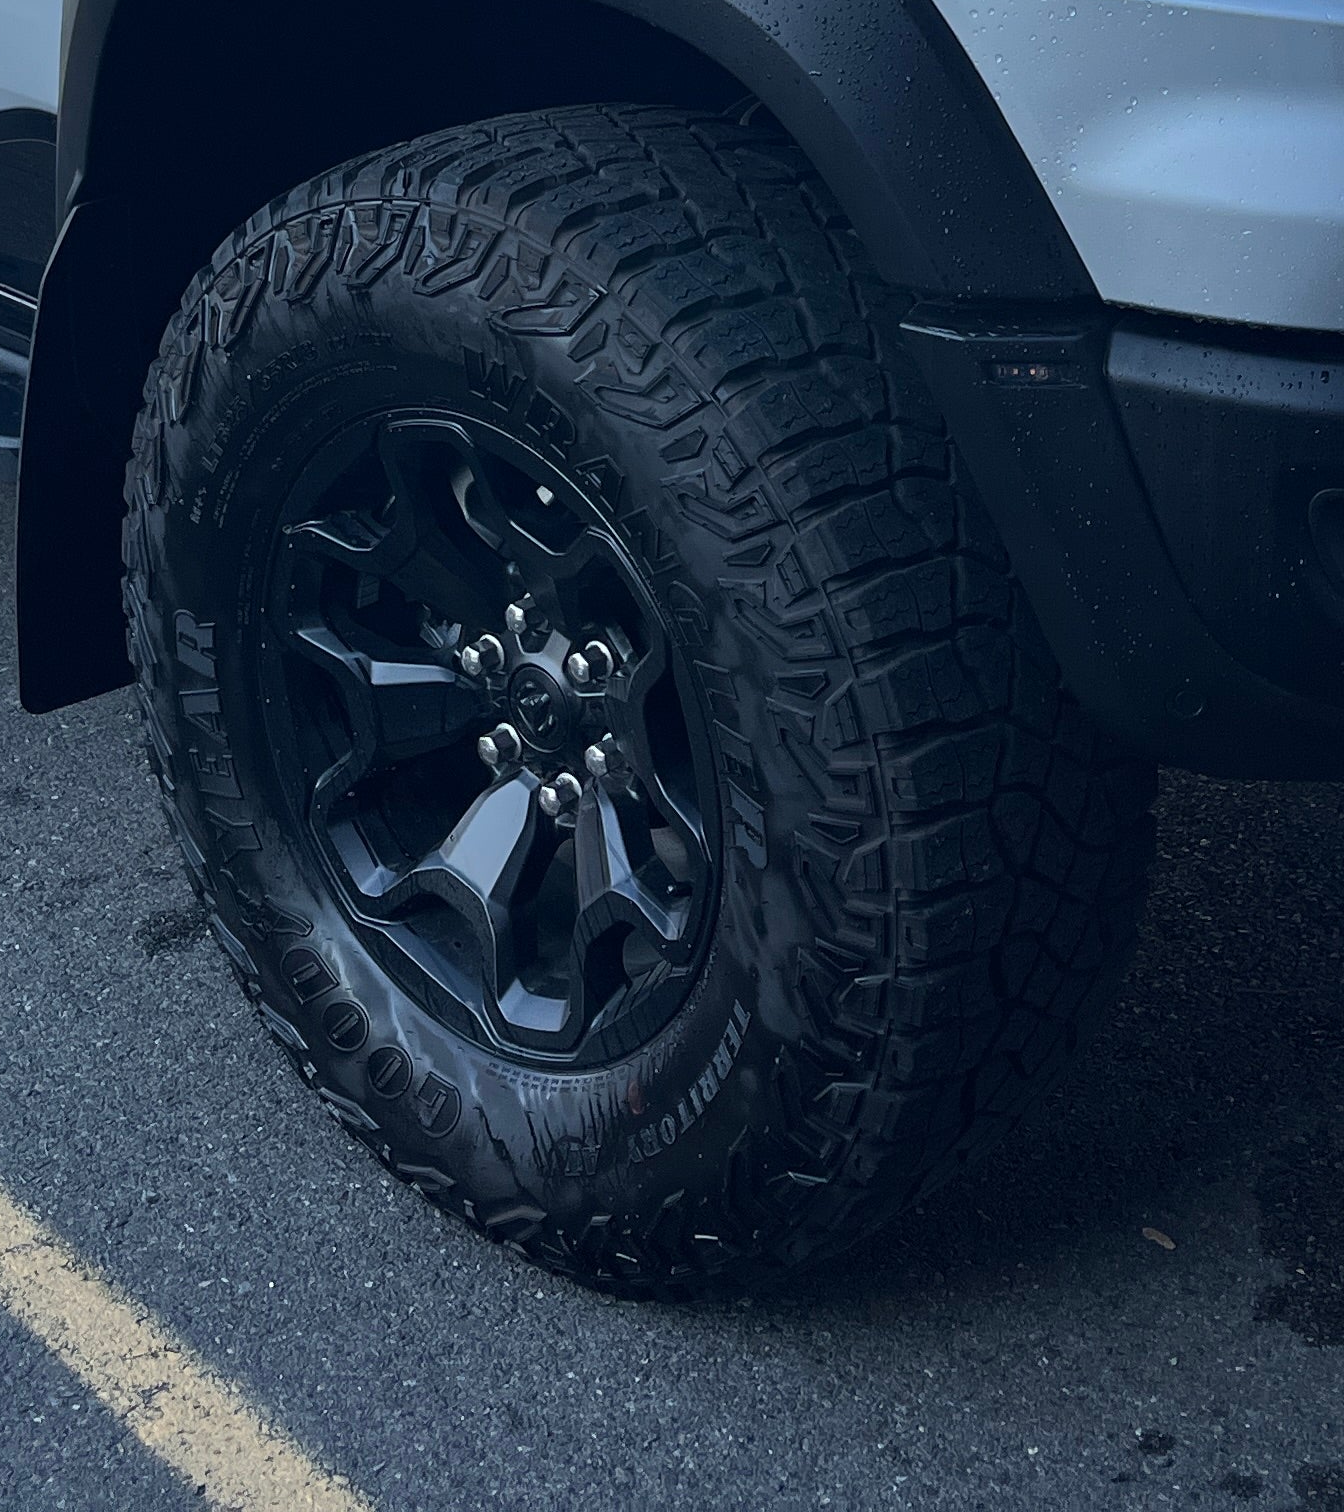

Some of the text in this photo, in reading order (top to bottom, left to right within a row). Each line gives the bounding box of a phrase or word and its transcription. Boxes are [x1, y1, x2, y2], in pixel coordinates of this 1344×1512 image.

[462, 344, 769, 869] WRANGLER
[175, 607, 462, 1139] GOODYEAR
[628, 998, 751, 1164] TERRITORY
